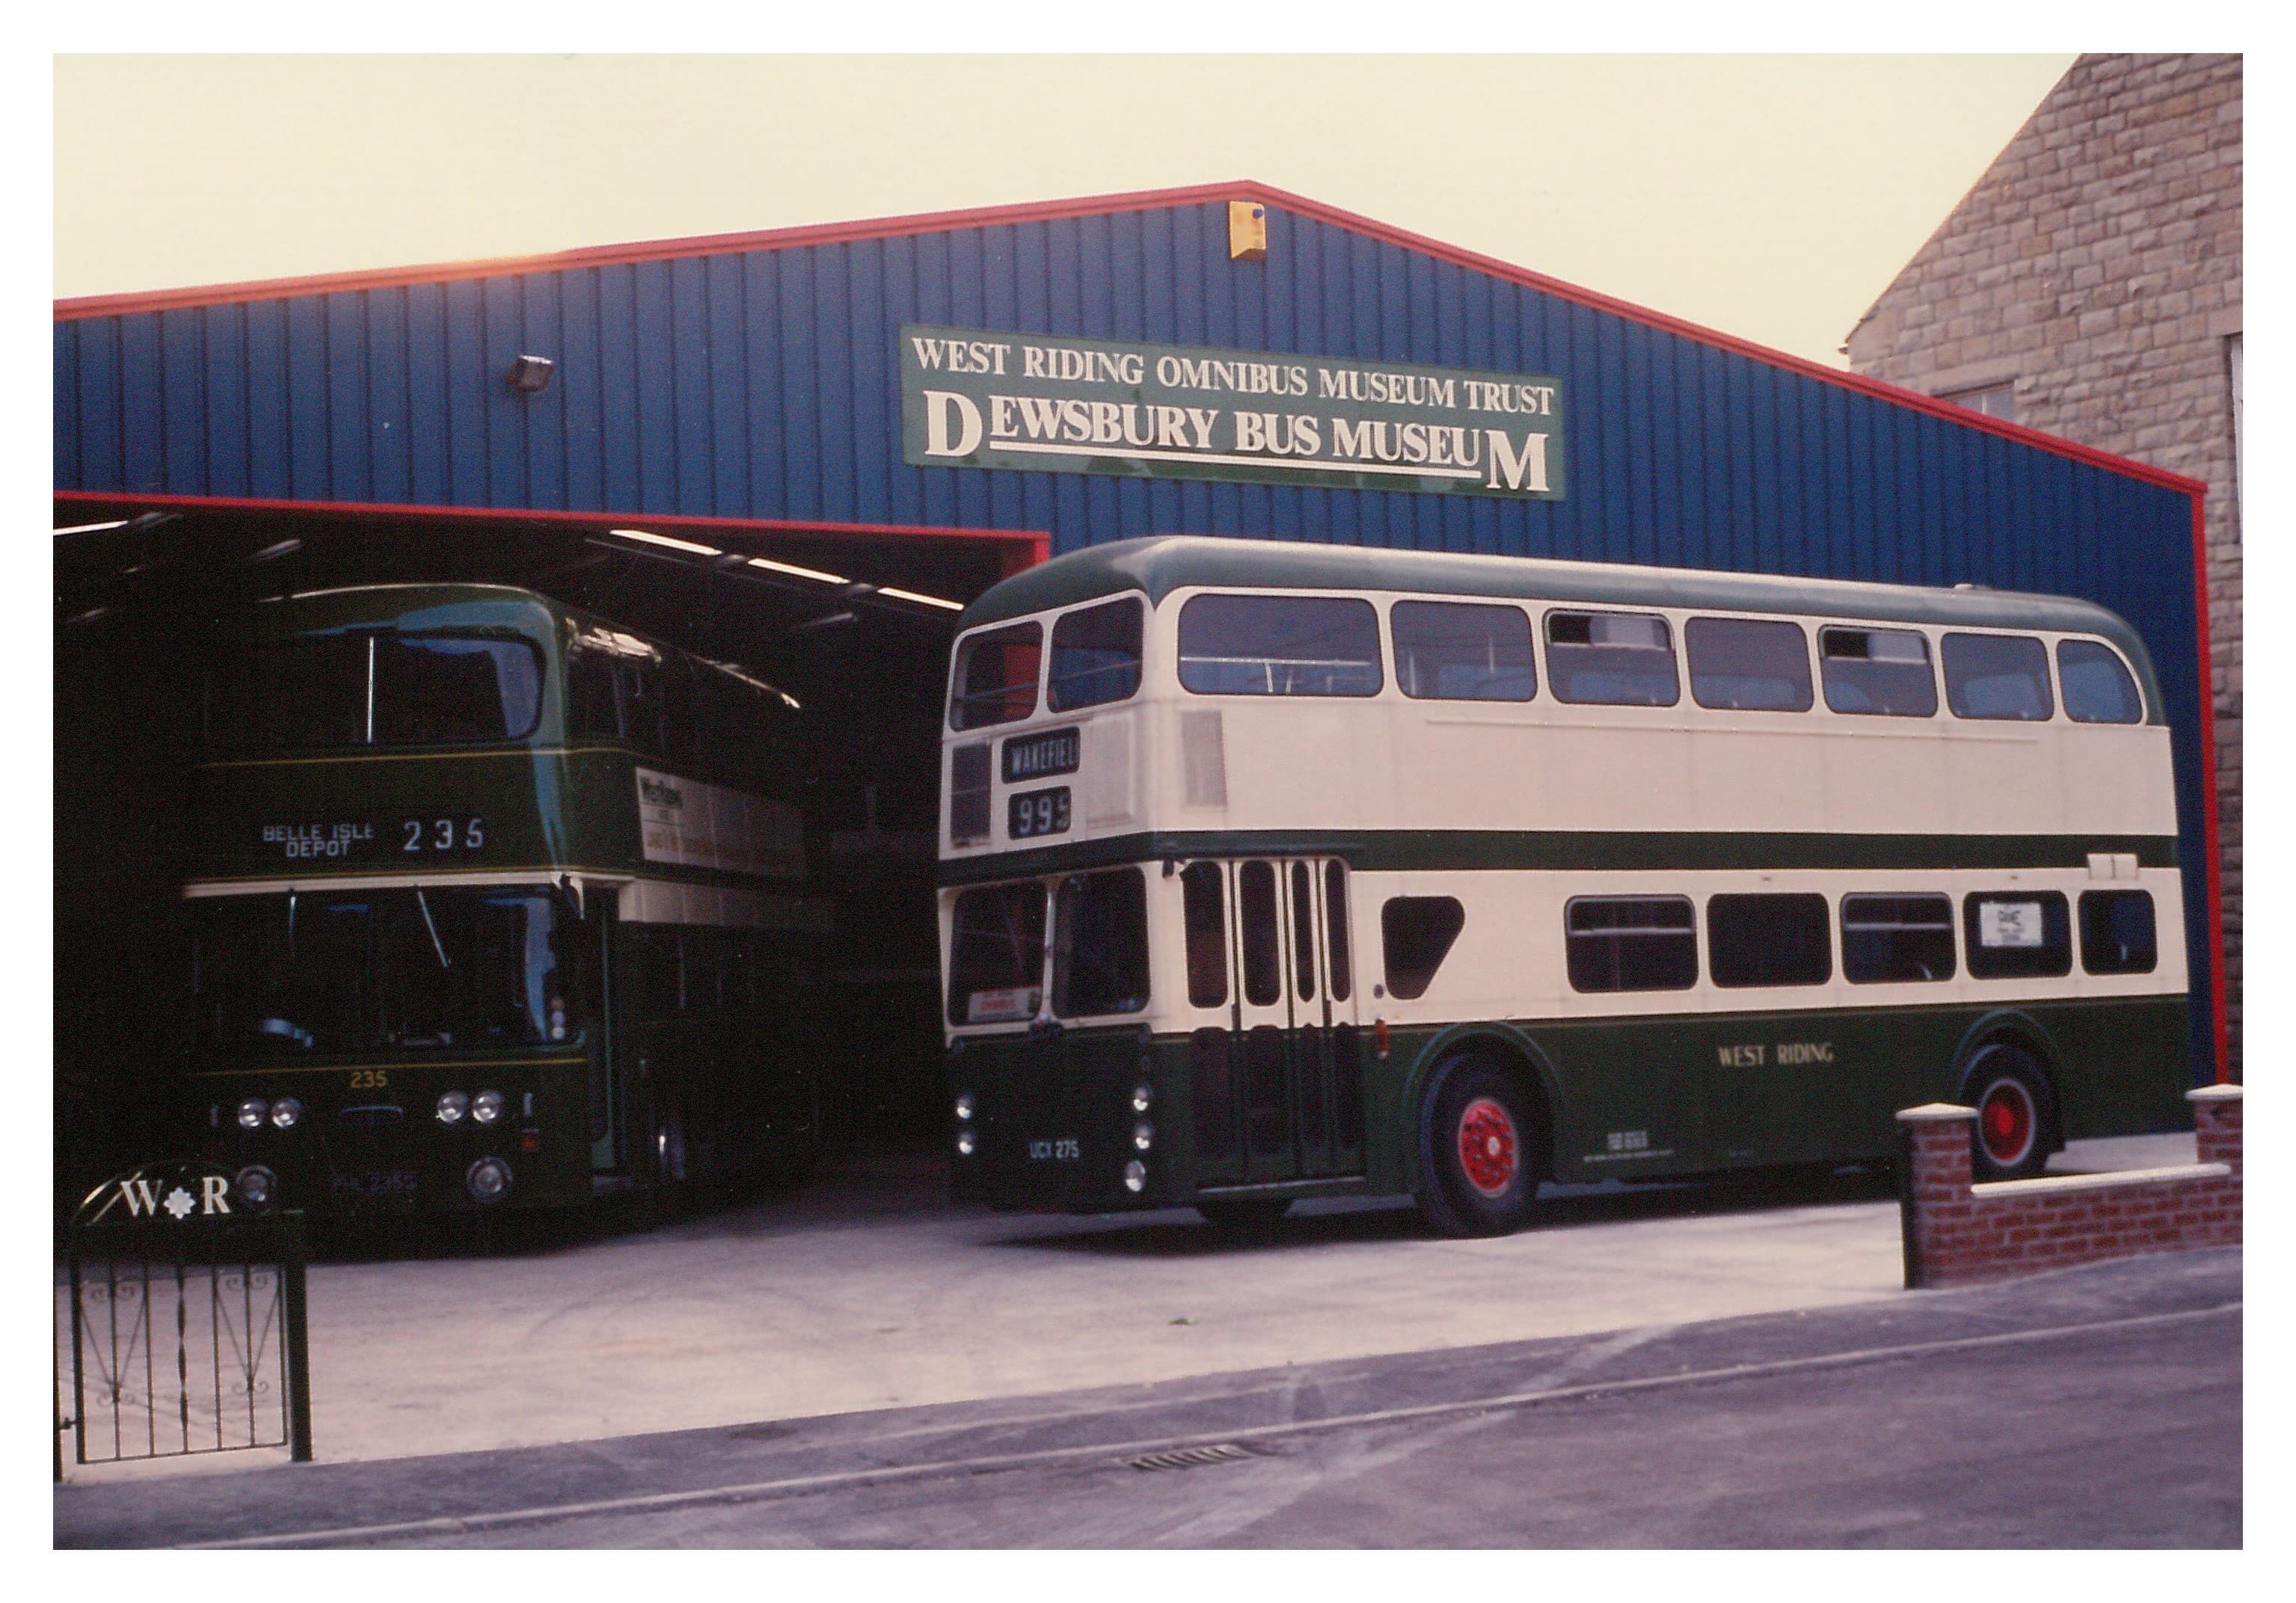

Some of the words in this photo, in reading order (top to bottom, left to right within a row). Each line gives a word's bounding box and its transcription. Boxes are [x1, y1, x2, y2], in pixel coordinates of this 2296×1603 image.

[912, 337, 1010, 375] WEST
[1023, 346, 1144, 385] RIDING
[1157, 355, 1308, 396] OMNIBUS
[1319, 369, 1456, 408] MUSEUM
[1464, 380, 1554, 416] TRUST
[923, 390, 1219, 457] DEWSBURY
[1233, 411, 1322, 455] BUS
[1332, 418, 1550, 492] MUSEUM
[1012, 737, 1080, 773] WAKEFIEL
[263, 824, 322, 842] BELLE
[334, 822, 374, 840] ISLE
[404, 818, 484, 852] 235
[286, 839, 351, 858] DEPOT
[1719, 1045, 1764, 1066] WEST
[1777, 1042, 1835, 1065] RIDING
[350, 1071, 387, 1089] 235
[1056, 1139, 1079, 1158] 275
[120, 1179, 163, 1217] W
[202, 1176, 231, 1215] R
